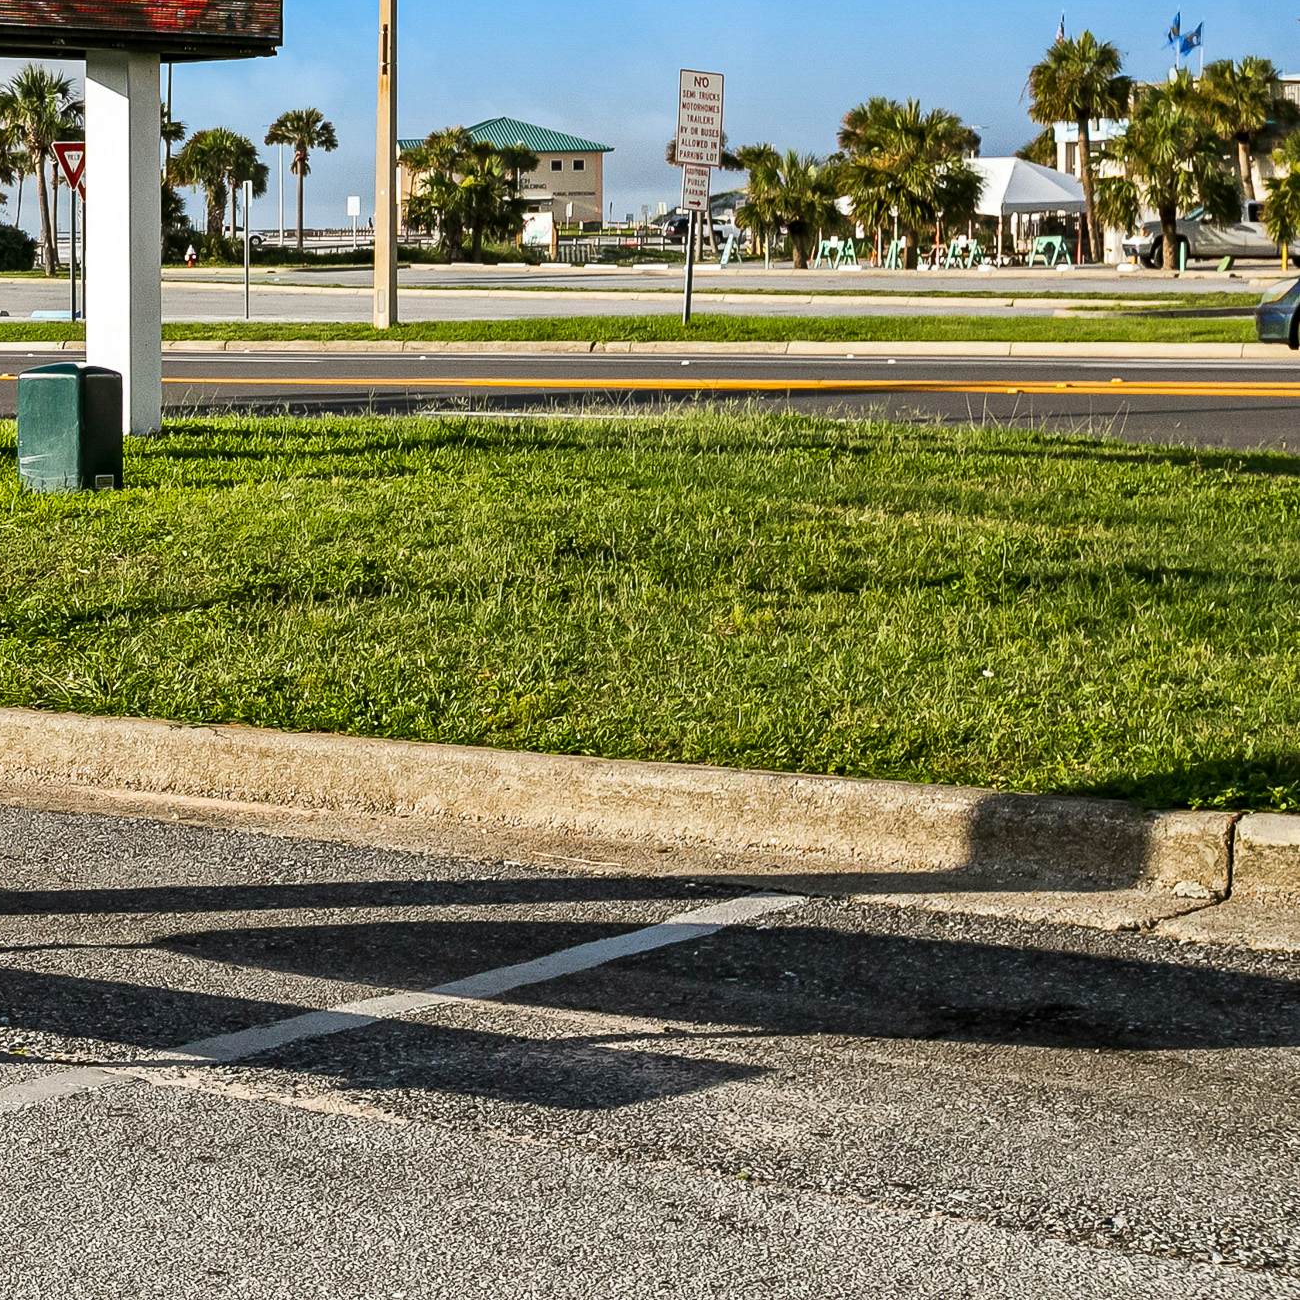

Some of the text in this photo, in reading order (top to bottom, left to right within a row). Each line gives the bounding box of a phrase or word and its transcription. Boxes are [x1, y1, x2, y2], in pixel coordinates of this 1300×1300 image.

[694, 76, 709, 88] NO
[683, 89, 720, 101] SEMI TRUCKS
[682, 102, 720, 113] MOTORHOMES
[687, 114, 714, 125] TRAILERS
[691, 126, 698, 135] OR
[701, 128, 719, 137] BUSES
[681, 138, 717, 149] ALLOWED IN
[680, 149, 717, 161] PARKING LOT
